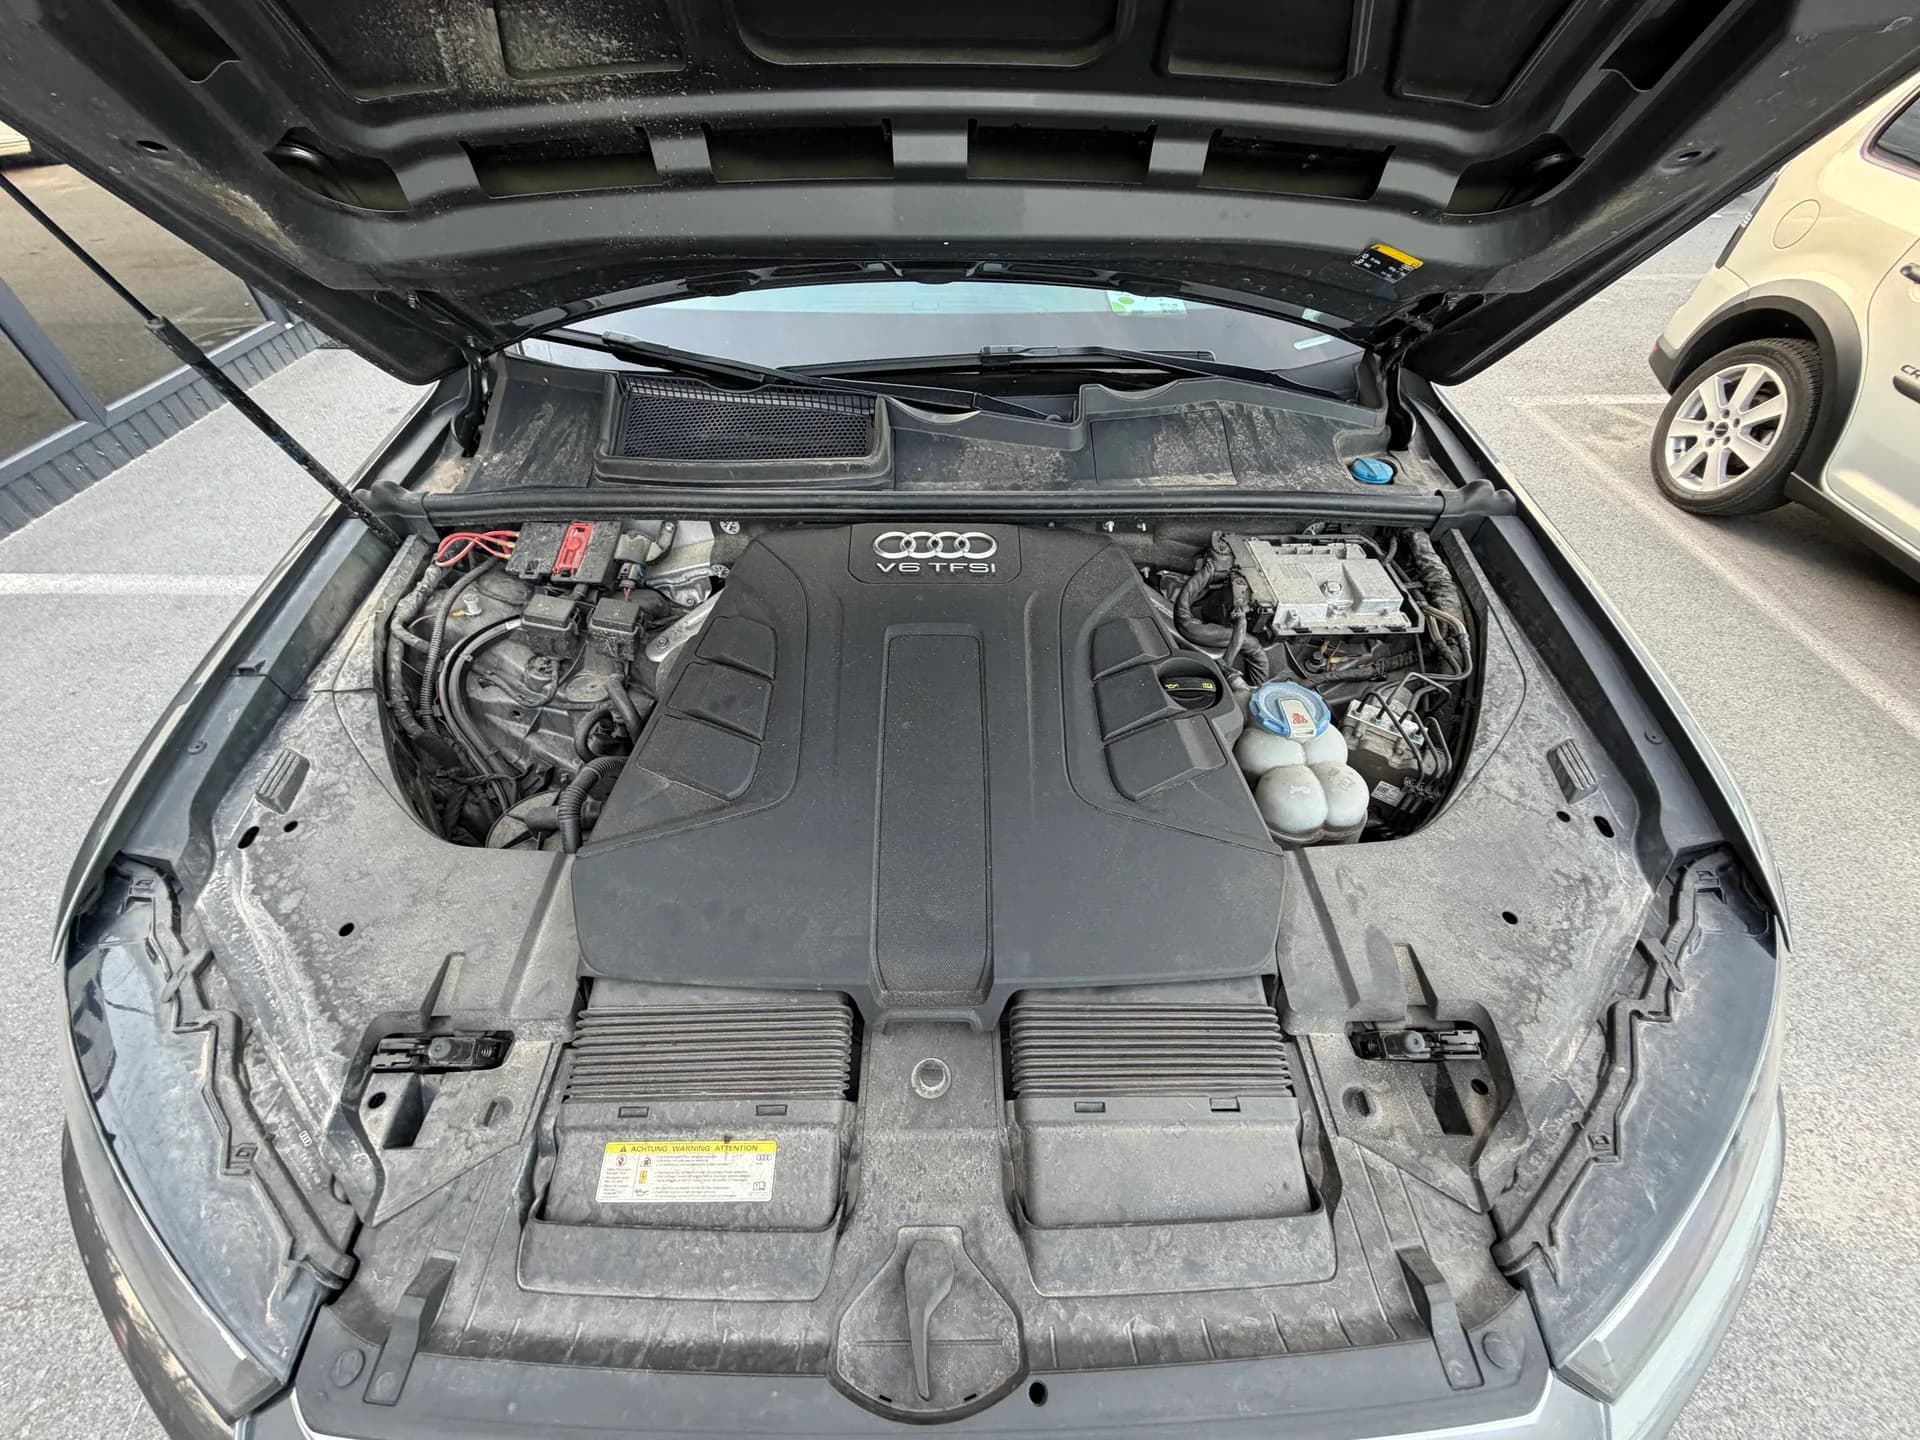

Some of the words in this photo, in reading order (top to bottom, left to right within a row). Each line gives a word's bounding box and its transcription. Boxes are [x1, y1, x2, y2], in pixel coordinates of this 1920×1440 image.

[876, 562, 921, 573] V6
[928, 562, 996, 573] TFSI
[630, 1145, 669, 1153] ACHTUNG
[672, 1145, 711, 1153] WARNING
[714, 1144, 758, 1152] ATTENTION
